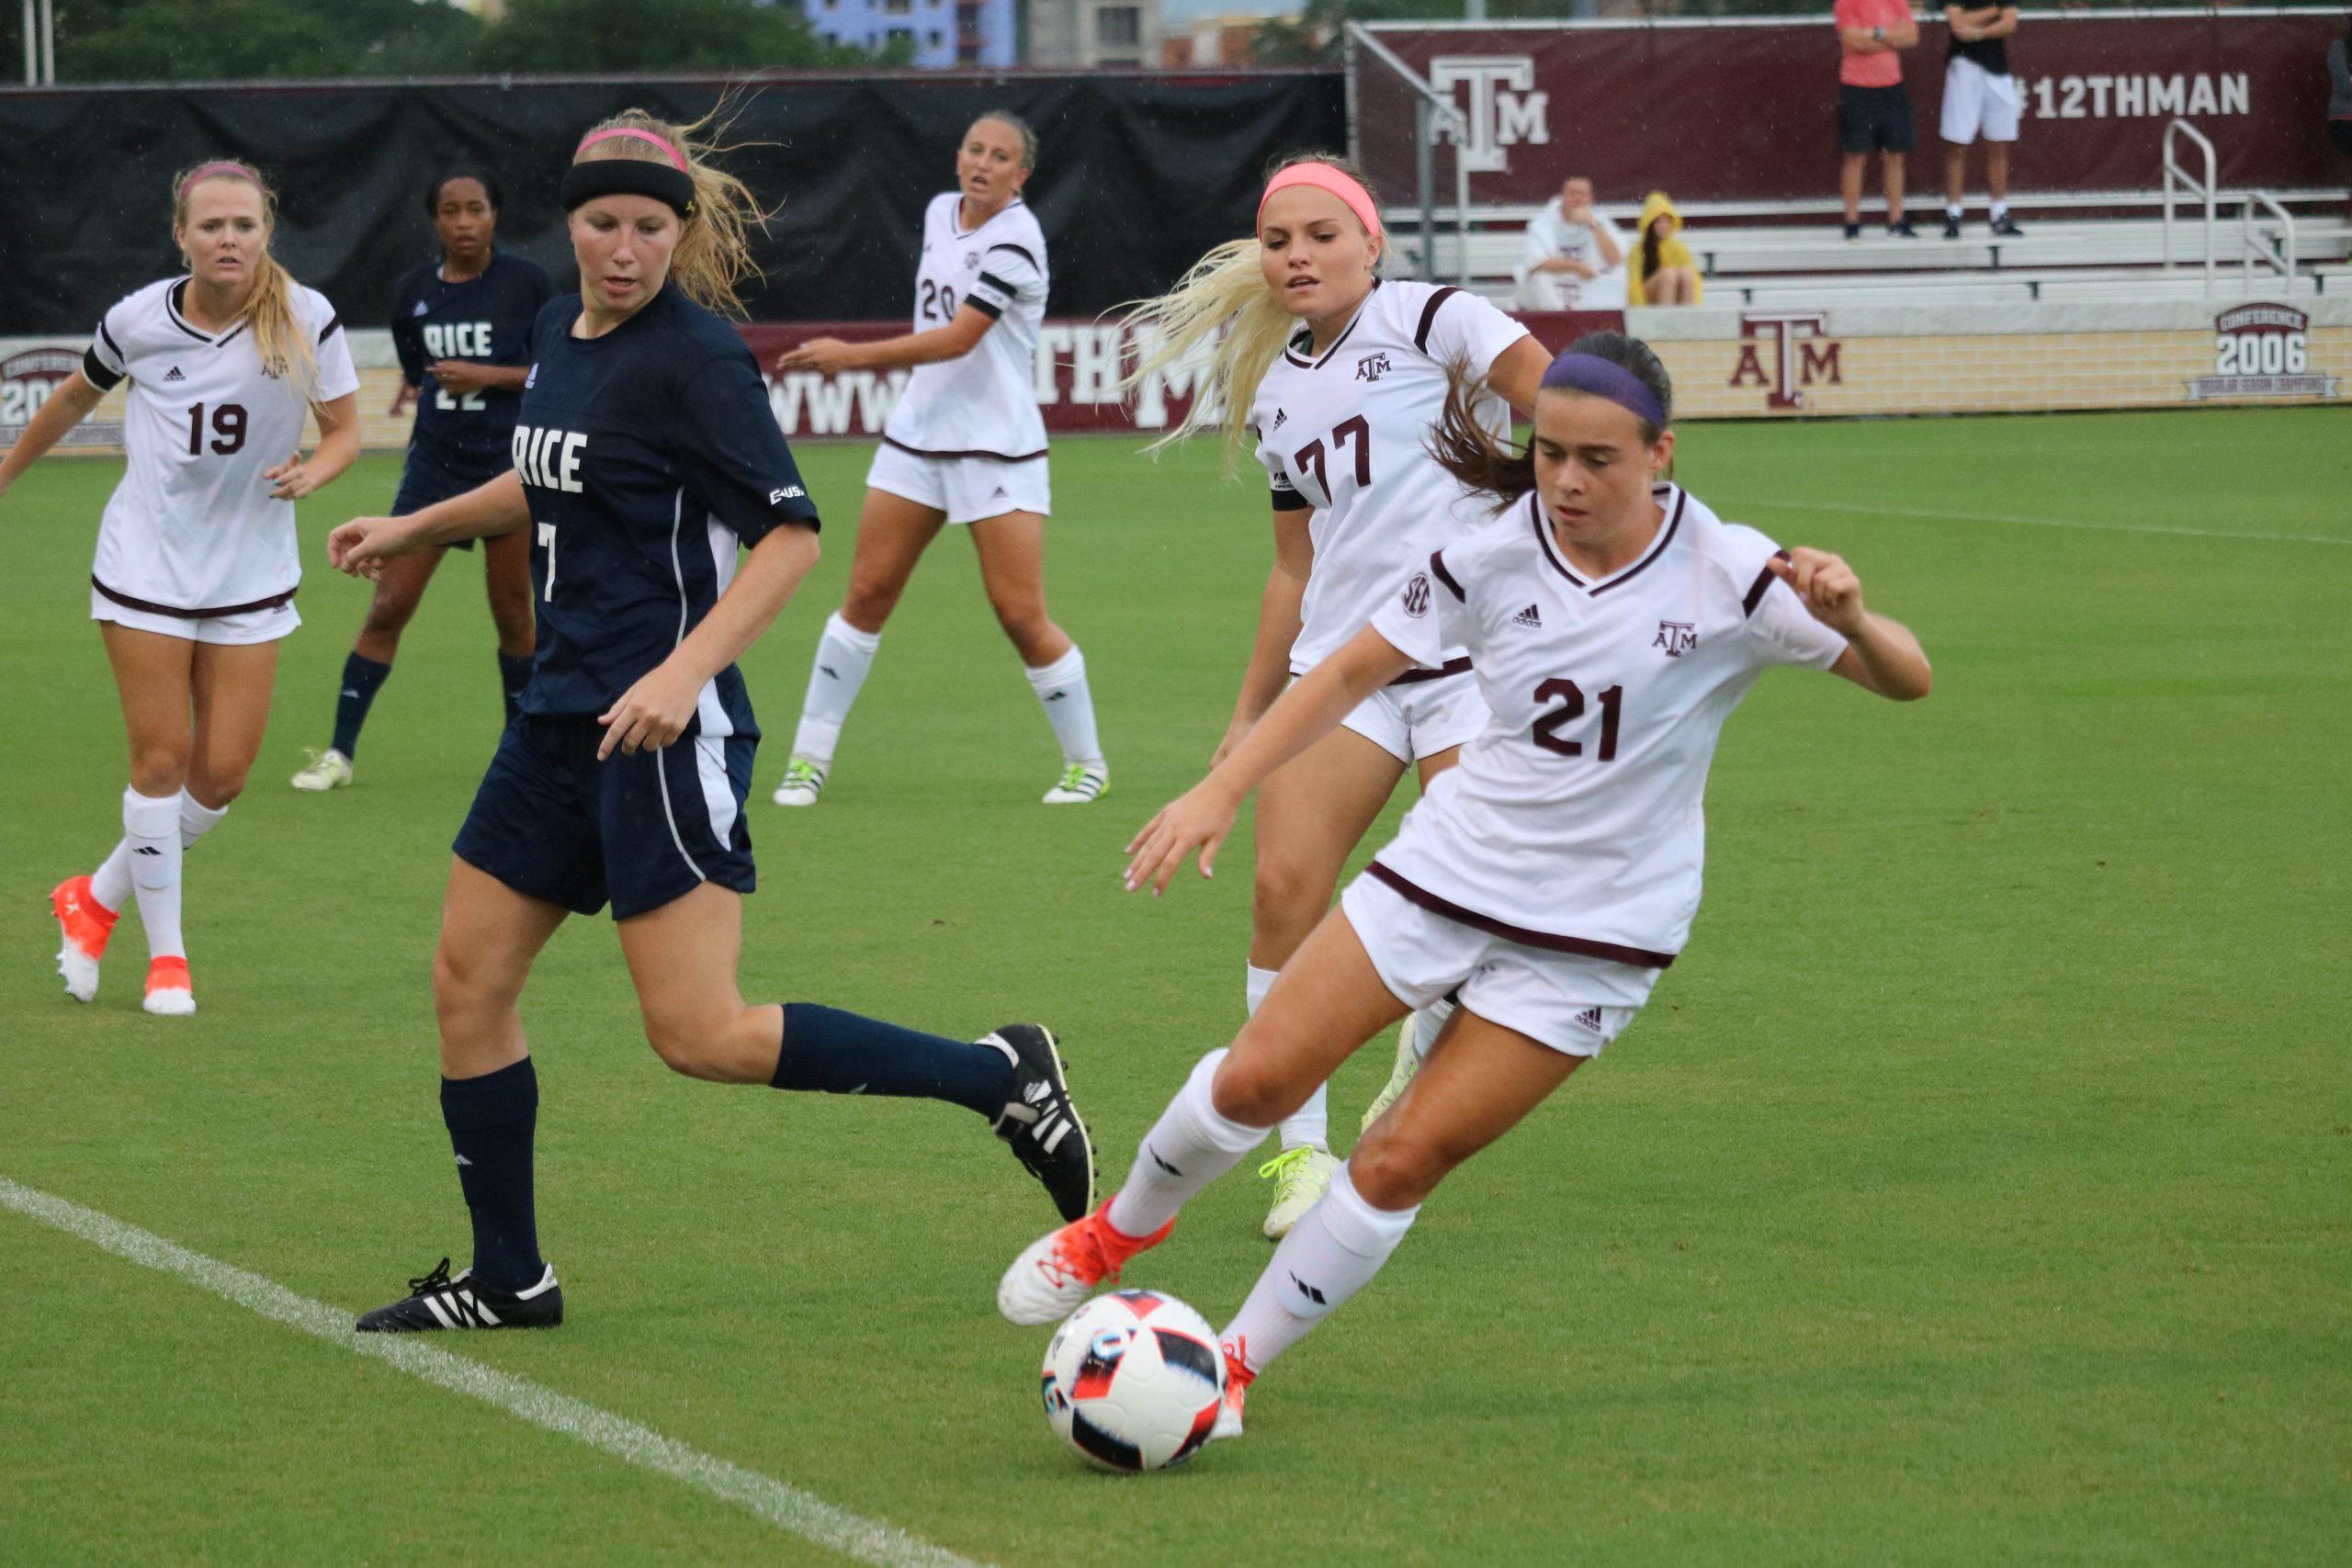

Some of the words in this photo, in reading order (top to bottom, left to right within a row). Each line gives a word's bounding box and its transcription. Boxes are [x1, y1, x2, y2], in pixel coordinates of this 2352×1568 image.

[922, 278, 955, 321] 20
[424, 321, 493, 358] RICE
[2215, 332, 2308, 376] 2006
[187, 401, 248, 456] 19
[512, 424, 588, 493] RICE
[1294, 413, 1372, 508] 77
[537, 521, 557, 603] 7
[1512, 616, 1543, 628] adidas
[1532, 677, 1624, 762] 21
